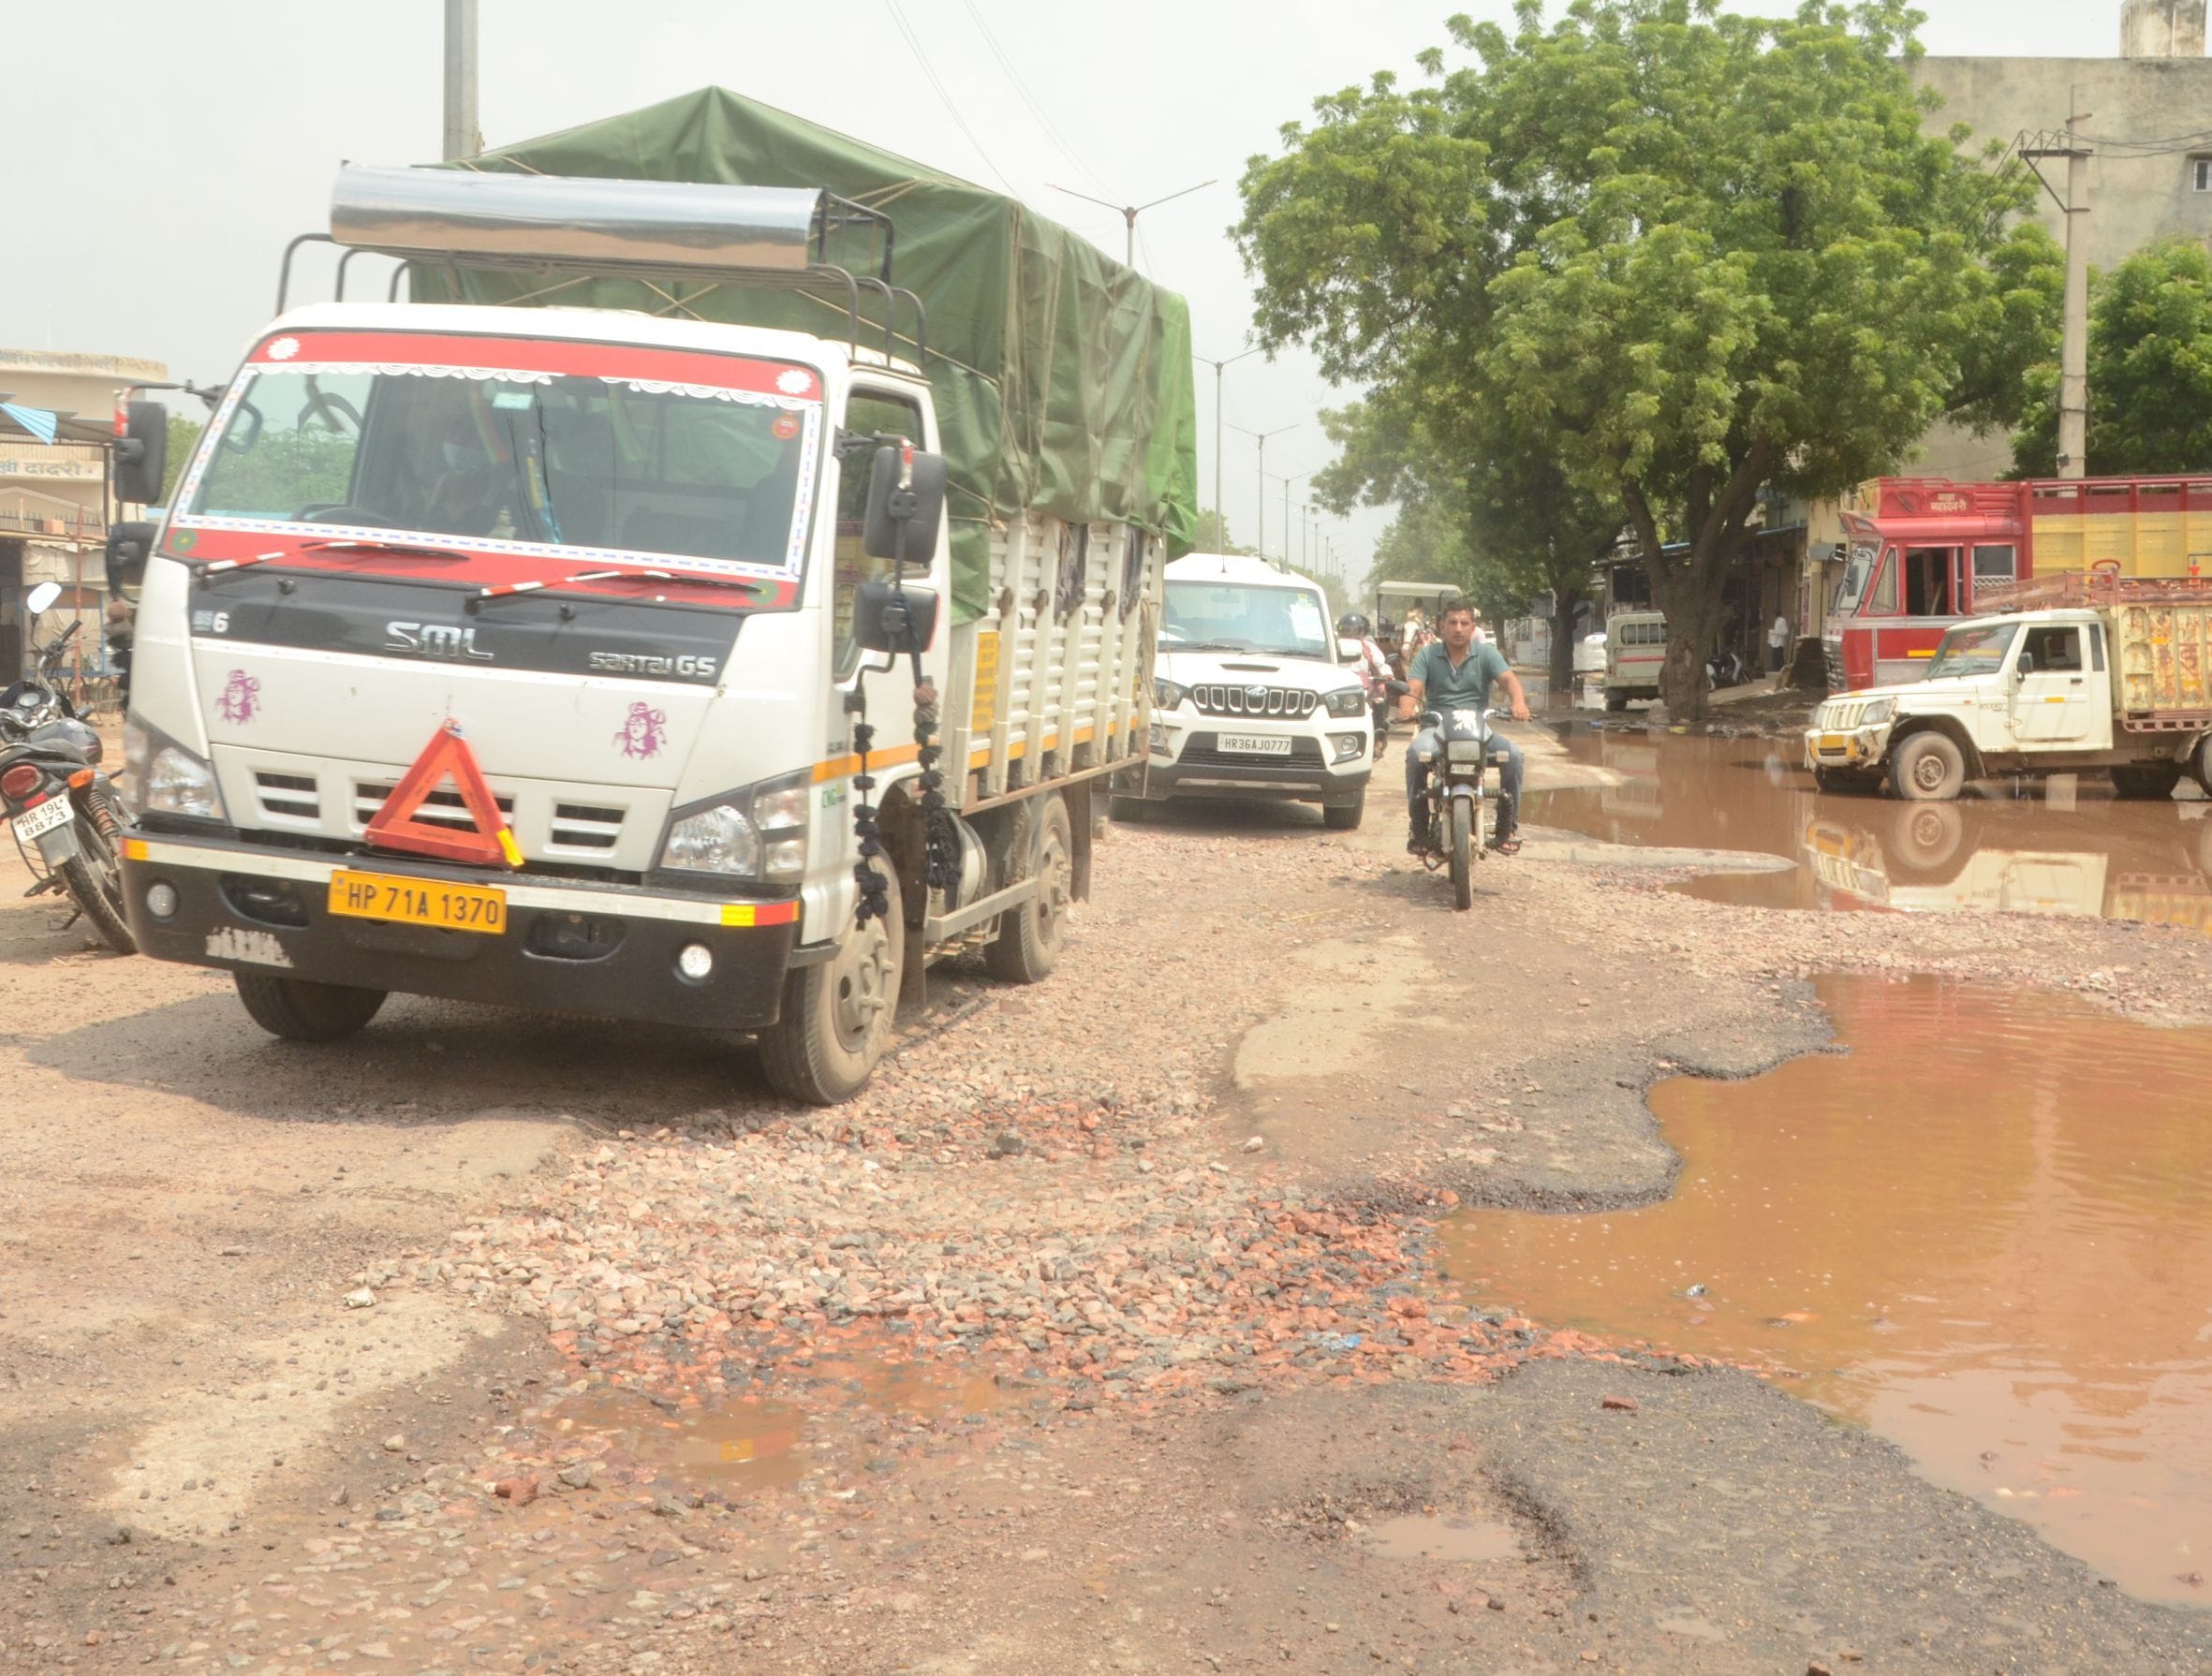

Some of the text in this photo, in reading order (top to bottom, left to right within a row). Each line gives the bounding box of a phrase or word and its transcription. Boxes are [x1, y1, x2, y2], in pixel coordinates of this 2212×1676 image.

[24, 460, 83, 477] दादरी
[384, 620, 495, 661] SML
[676, 654, 717, 678] GS
[1225, 738, 1290, 752] HR36AJ0777
[22, 812, 38, 828] HR
[24, 811, 66, 837] 8873
[347, 882, 499, 925] HP 71A 1370
